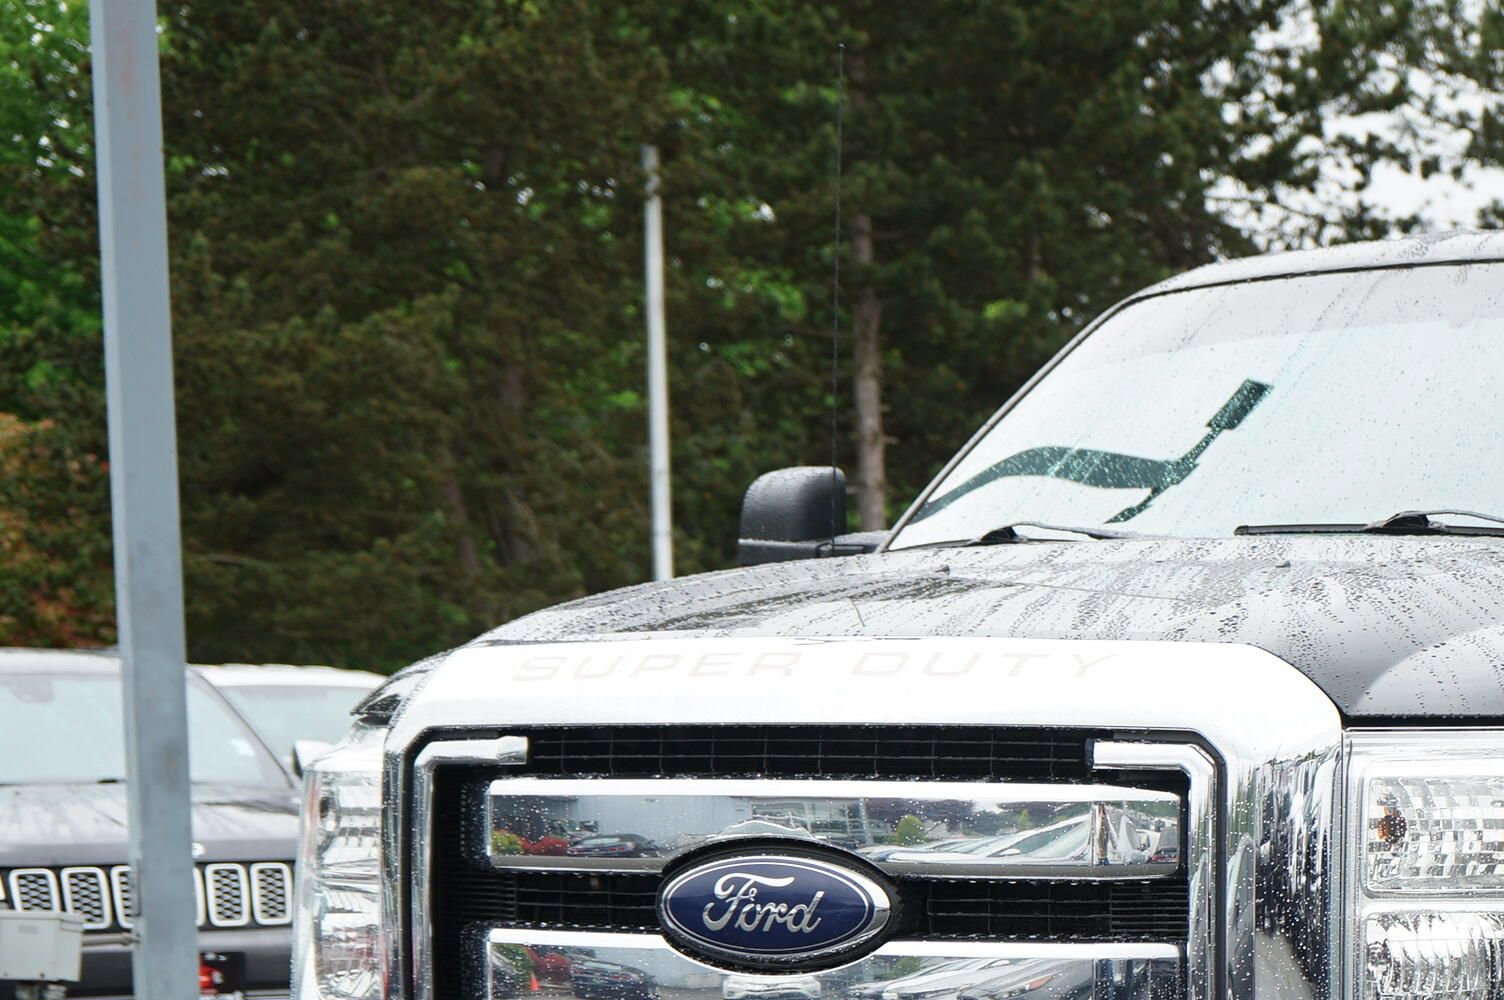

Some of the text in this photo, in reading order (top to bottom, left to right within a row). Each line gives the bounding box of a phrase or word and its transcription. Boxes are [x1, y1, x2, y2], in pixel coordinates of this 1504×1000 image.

[512, 651, 1119, 682] SUPER DUTY
[702, 872, 825, 934] Ford
